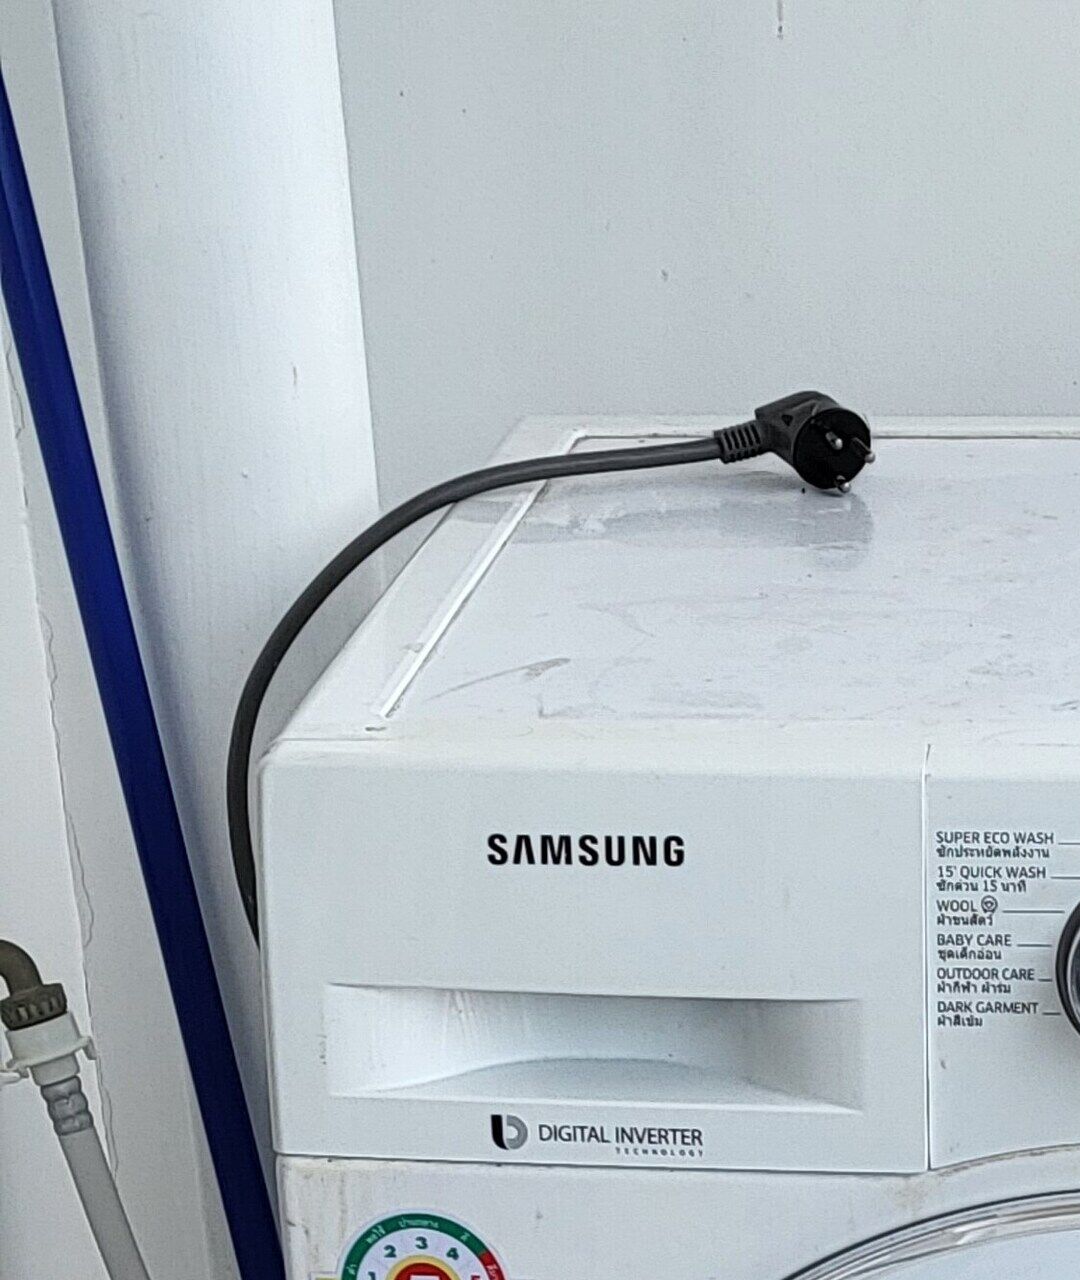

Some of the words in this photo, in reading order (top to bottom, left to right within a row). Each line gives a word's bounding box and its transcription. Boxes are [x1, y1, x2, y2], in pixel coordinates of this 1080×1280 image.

[936, 831, 980, 844] SUPER
[983, 831, 1010, 844] ECO
[1013, 831, 1054, 845] WASH
[487, 833, 685, 867] SAMSUNG
[960, 866, 1002, 880] QUICK
[1005, 866, 1047, 879] WASH
[983, 880, 998, 892] 15
[936, 899, 978, 912] WOOL
[937, 934, 973, 946] BABY
[976, 934, 1012, 947] CARE
[936, 967, 999, 980] OUTDOOR
[1001, 968, 1036, 981] CARE
[937, 1001, 973, 1014] DARK
[976, 1001, 1039, 1014] GARMENT
[538, 1124, 611, 1144] DIGITAL
[615, 1126, 704, 1147] INVERTER
[384, 1244, 397, 1258] 2
[415, 1236, 429, 1250] 3
[446, 1247, 460, 1261] 4
